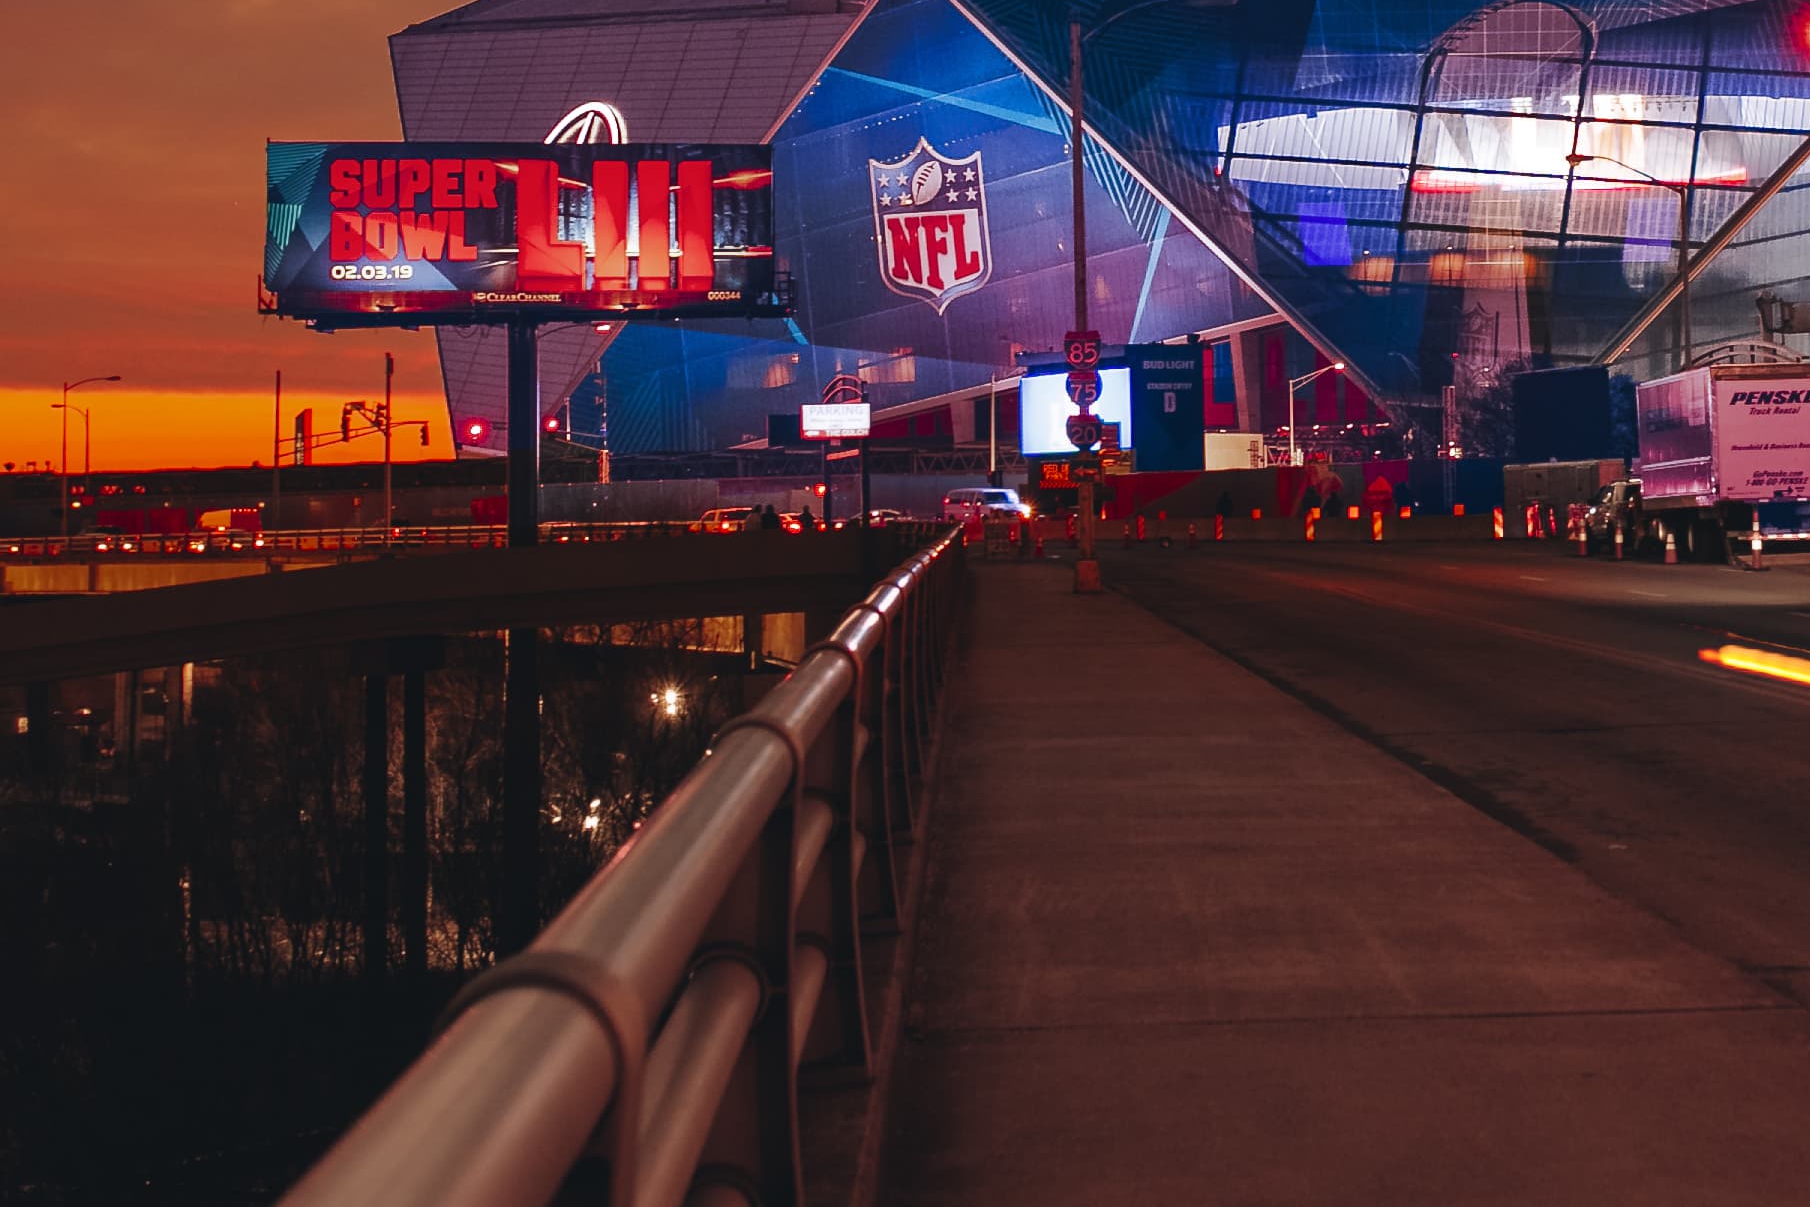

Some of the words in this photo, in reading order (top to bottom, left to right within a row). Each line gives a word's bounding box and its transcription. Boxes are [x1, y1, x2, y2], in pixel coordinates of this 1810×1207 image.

[329, 158, 499, 209] SUPER
[329, 210, 479, 261] BOWL
[516, 159, 715, 292] LIII
[887, 214, 981, 290] NFL
[331, 265, 414, 280] 02.03.19
[1069, 342, 1098, 363] 85
[1143, 360, 1165, 370] BUD
[1165, 360, 1195, 370] LIGHT
[1070, 383, 1098, 402] 75
[1749, 407, 1771, 415] Truck
[1773, 406, 1801, 414] Rental
[1071, 426, 1097, 444] 20
